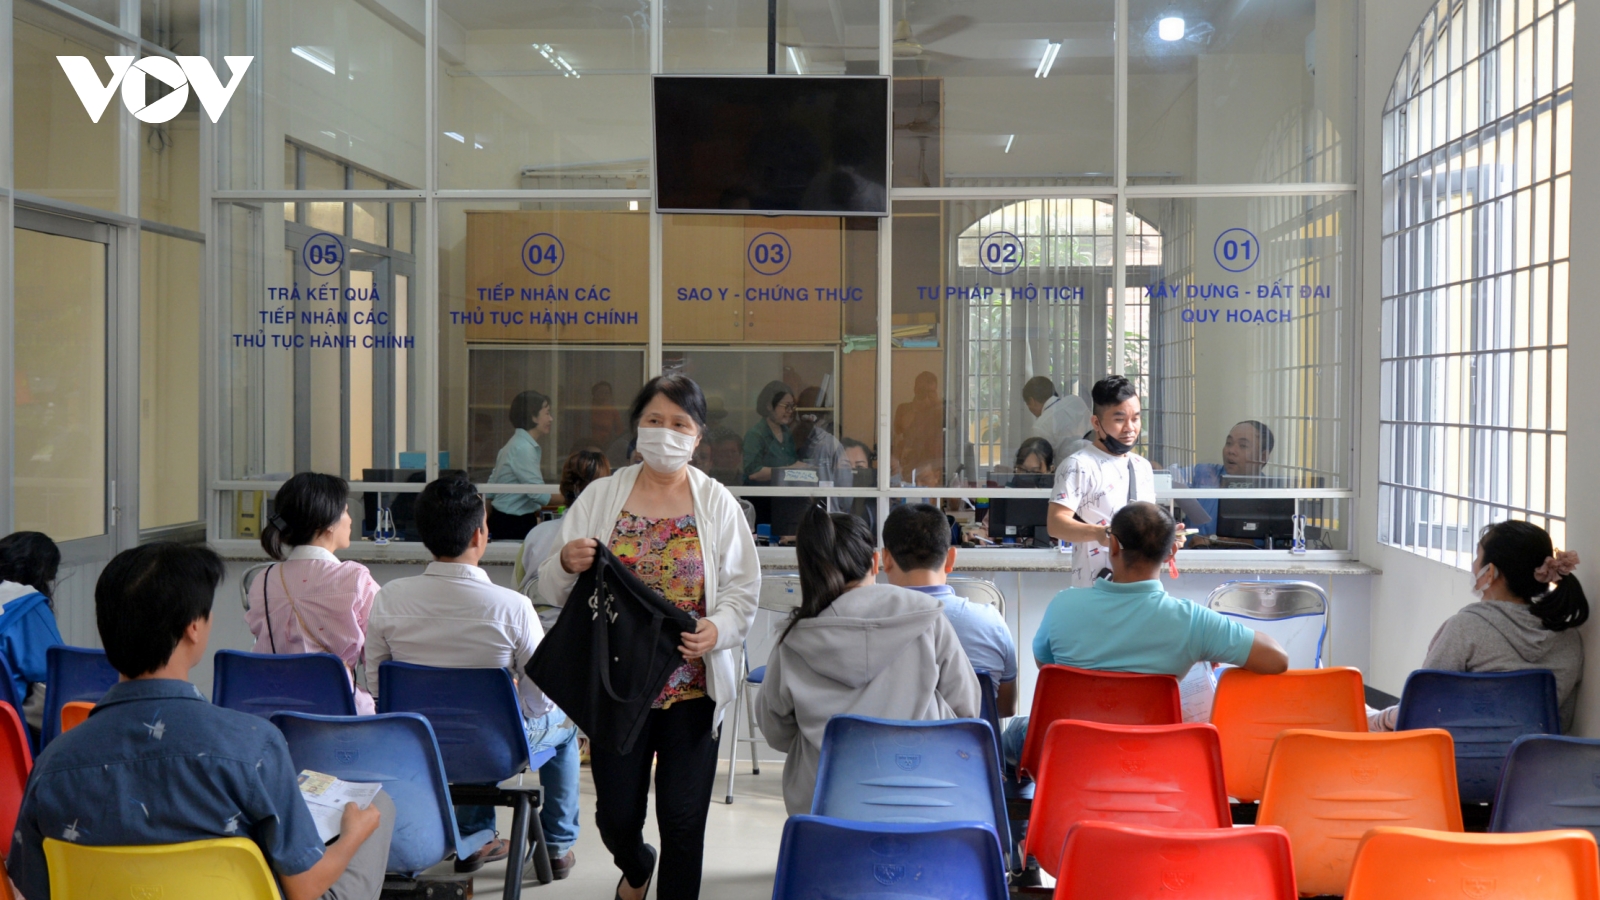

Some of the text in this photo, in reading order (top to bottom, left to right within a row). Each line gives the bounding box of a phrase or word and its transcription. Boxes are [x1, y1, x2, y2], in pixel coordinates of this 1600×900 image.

[309, 244, 338, 265] 05
[528, 244, 558, 264] 04
[755, 243, 784, 264] 03
[986, 243, 1017, 263] 02
[1223, 239, 1251, 261] 01
[268, 282, 380, 301] TRẢ KẾT QUẢ
[477, 282, 611, 304] TIẾP NHẬN CÁC
[677, 287, 713, 301] SAO
[718, 287, 729, 301] Y
[745, 284, 809, 301] CHỨNG
[814, 286, 863, 304] THỰC
[917, 285, 940, 300] TƯ
[946, 283, 994, 300] PHÁP
[1012, 283, 1037, 303] HỘ
[1043, 286, 1084, 303] TỊCH
[1145, 281, 1180, 298] XÂY
[1187, 283, 1239, 301] DỰNG
[1257, 279, 1294, 299] ĐẤT
[1300, 285, 1331, 299] ĐAI
[259, 306, 389, 327] TIẾP NHẬN CÁC
[450, 306, 639, 327] THỦ TỤC HÀNH CHÍNH
[1181, 309, 1292, 326] QUY HOẠCH
[233, 329, 415, 351] THỦ TỤC HÀNH CHÍNH
